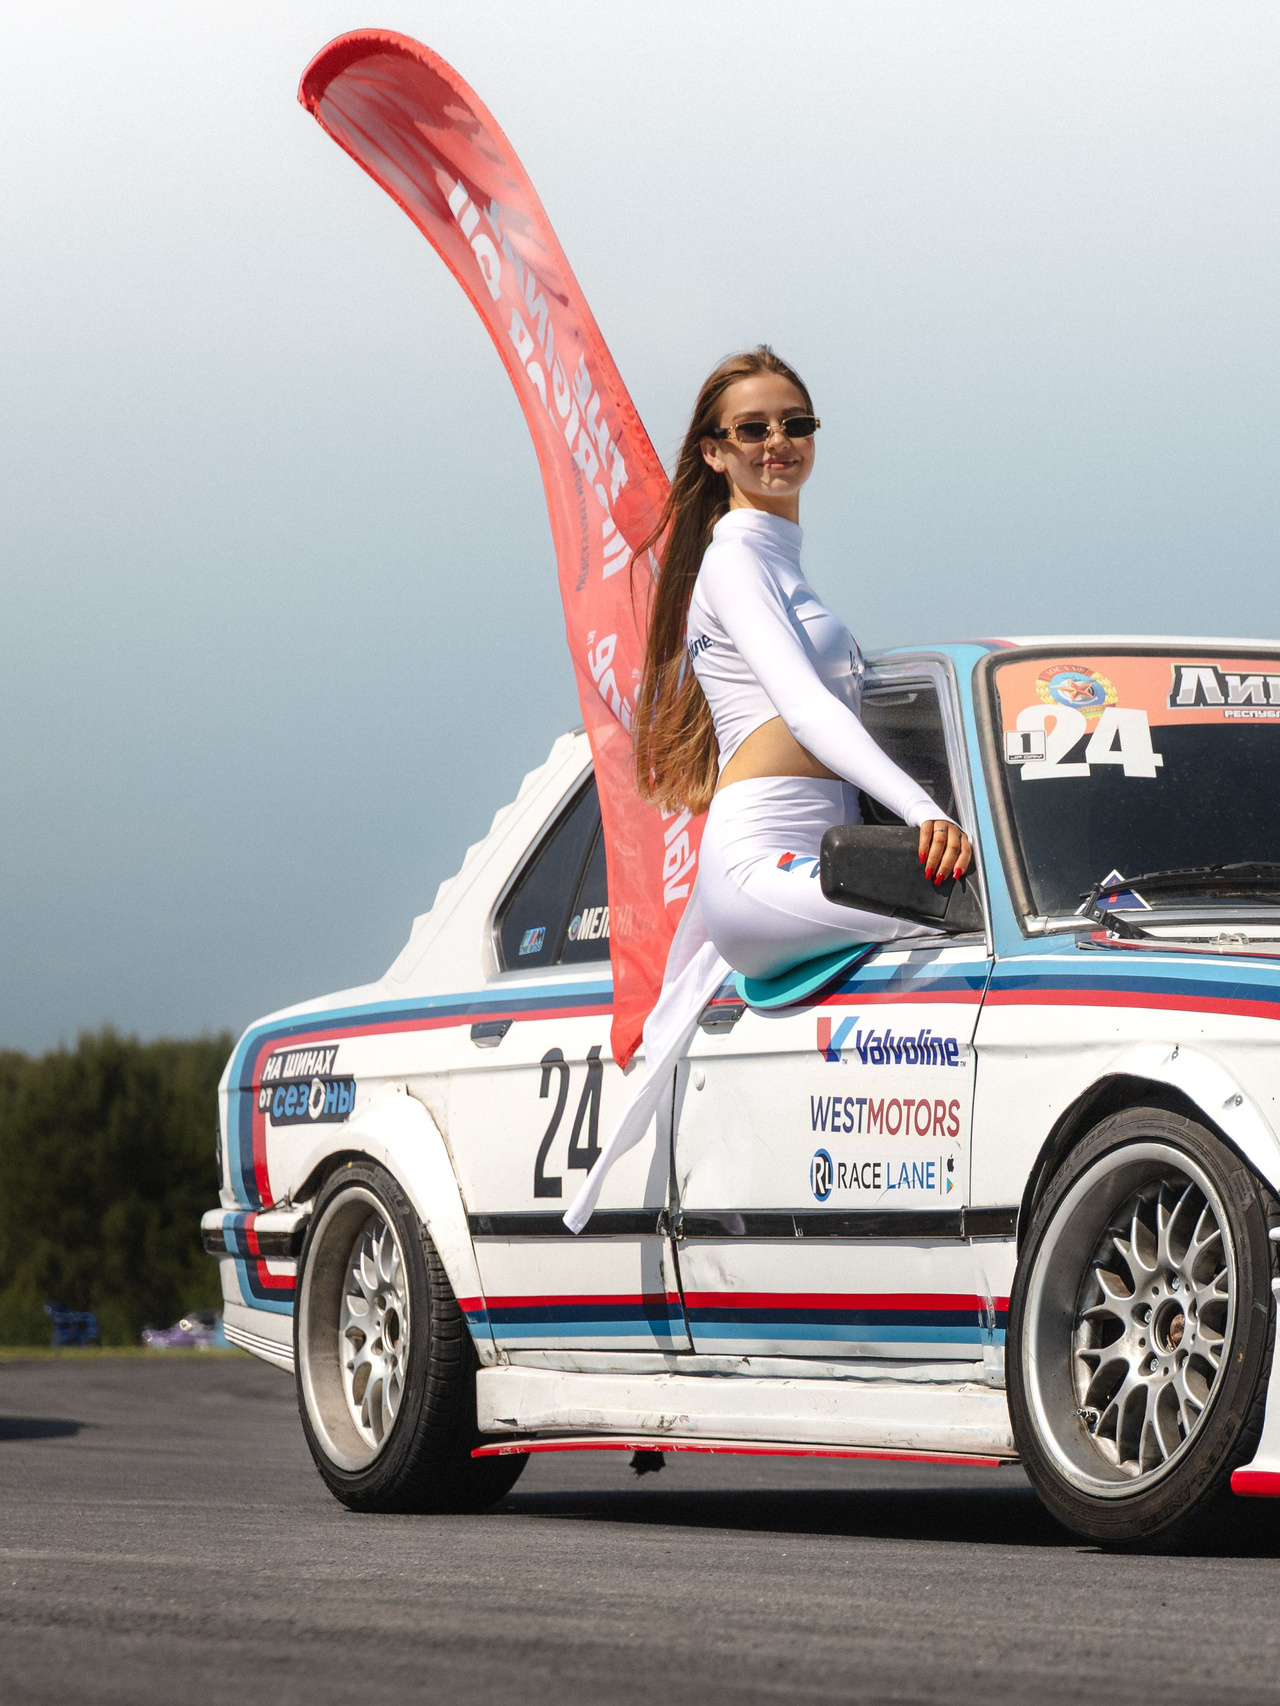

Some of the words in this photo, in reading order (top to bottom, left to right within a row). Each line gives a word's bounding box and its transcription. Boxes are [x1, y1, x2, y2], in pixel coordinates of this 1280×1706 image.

[1016, 704, 1164, 781] 24
[1020, 733, 1032, 753] 1
[262, 1055, 283, 1081] НА
[282, 1049, 336, 1079] ШИНАХ
[856, 1028, 960, 1067] Valvoline
[533, 1045, 604, 1198] 24
[810, 1095, 961, 1138] WESTMOTORS
[837, 1162, 882, 1189] RACE
[886, 1161, 936, 1190] LANE
